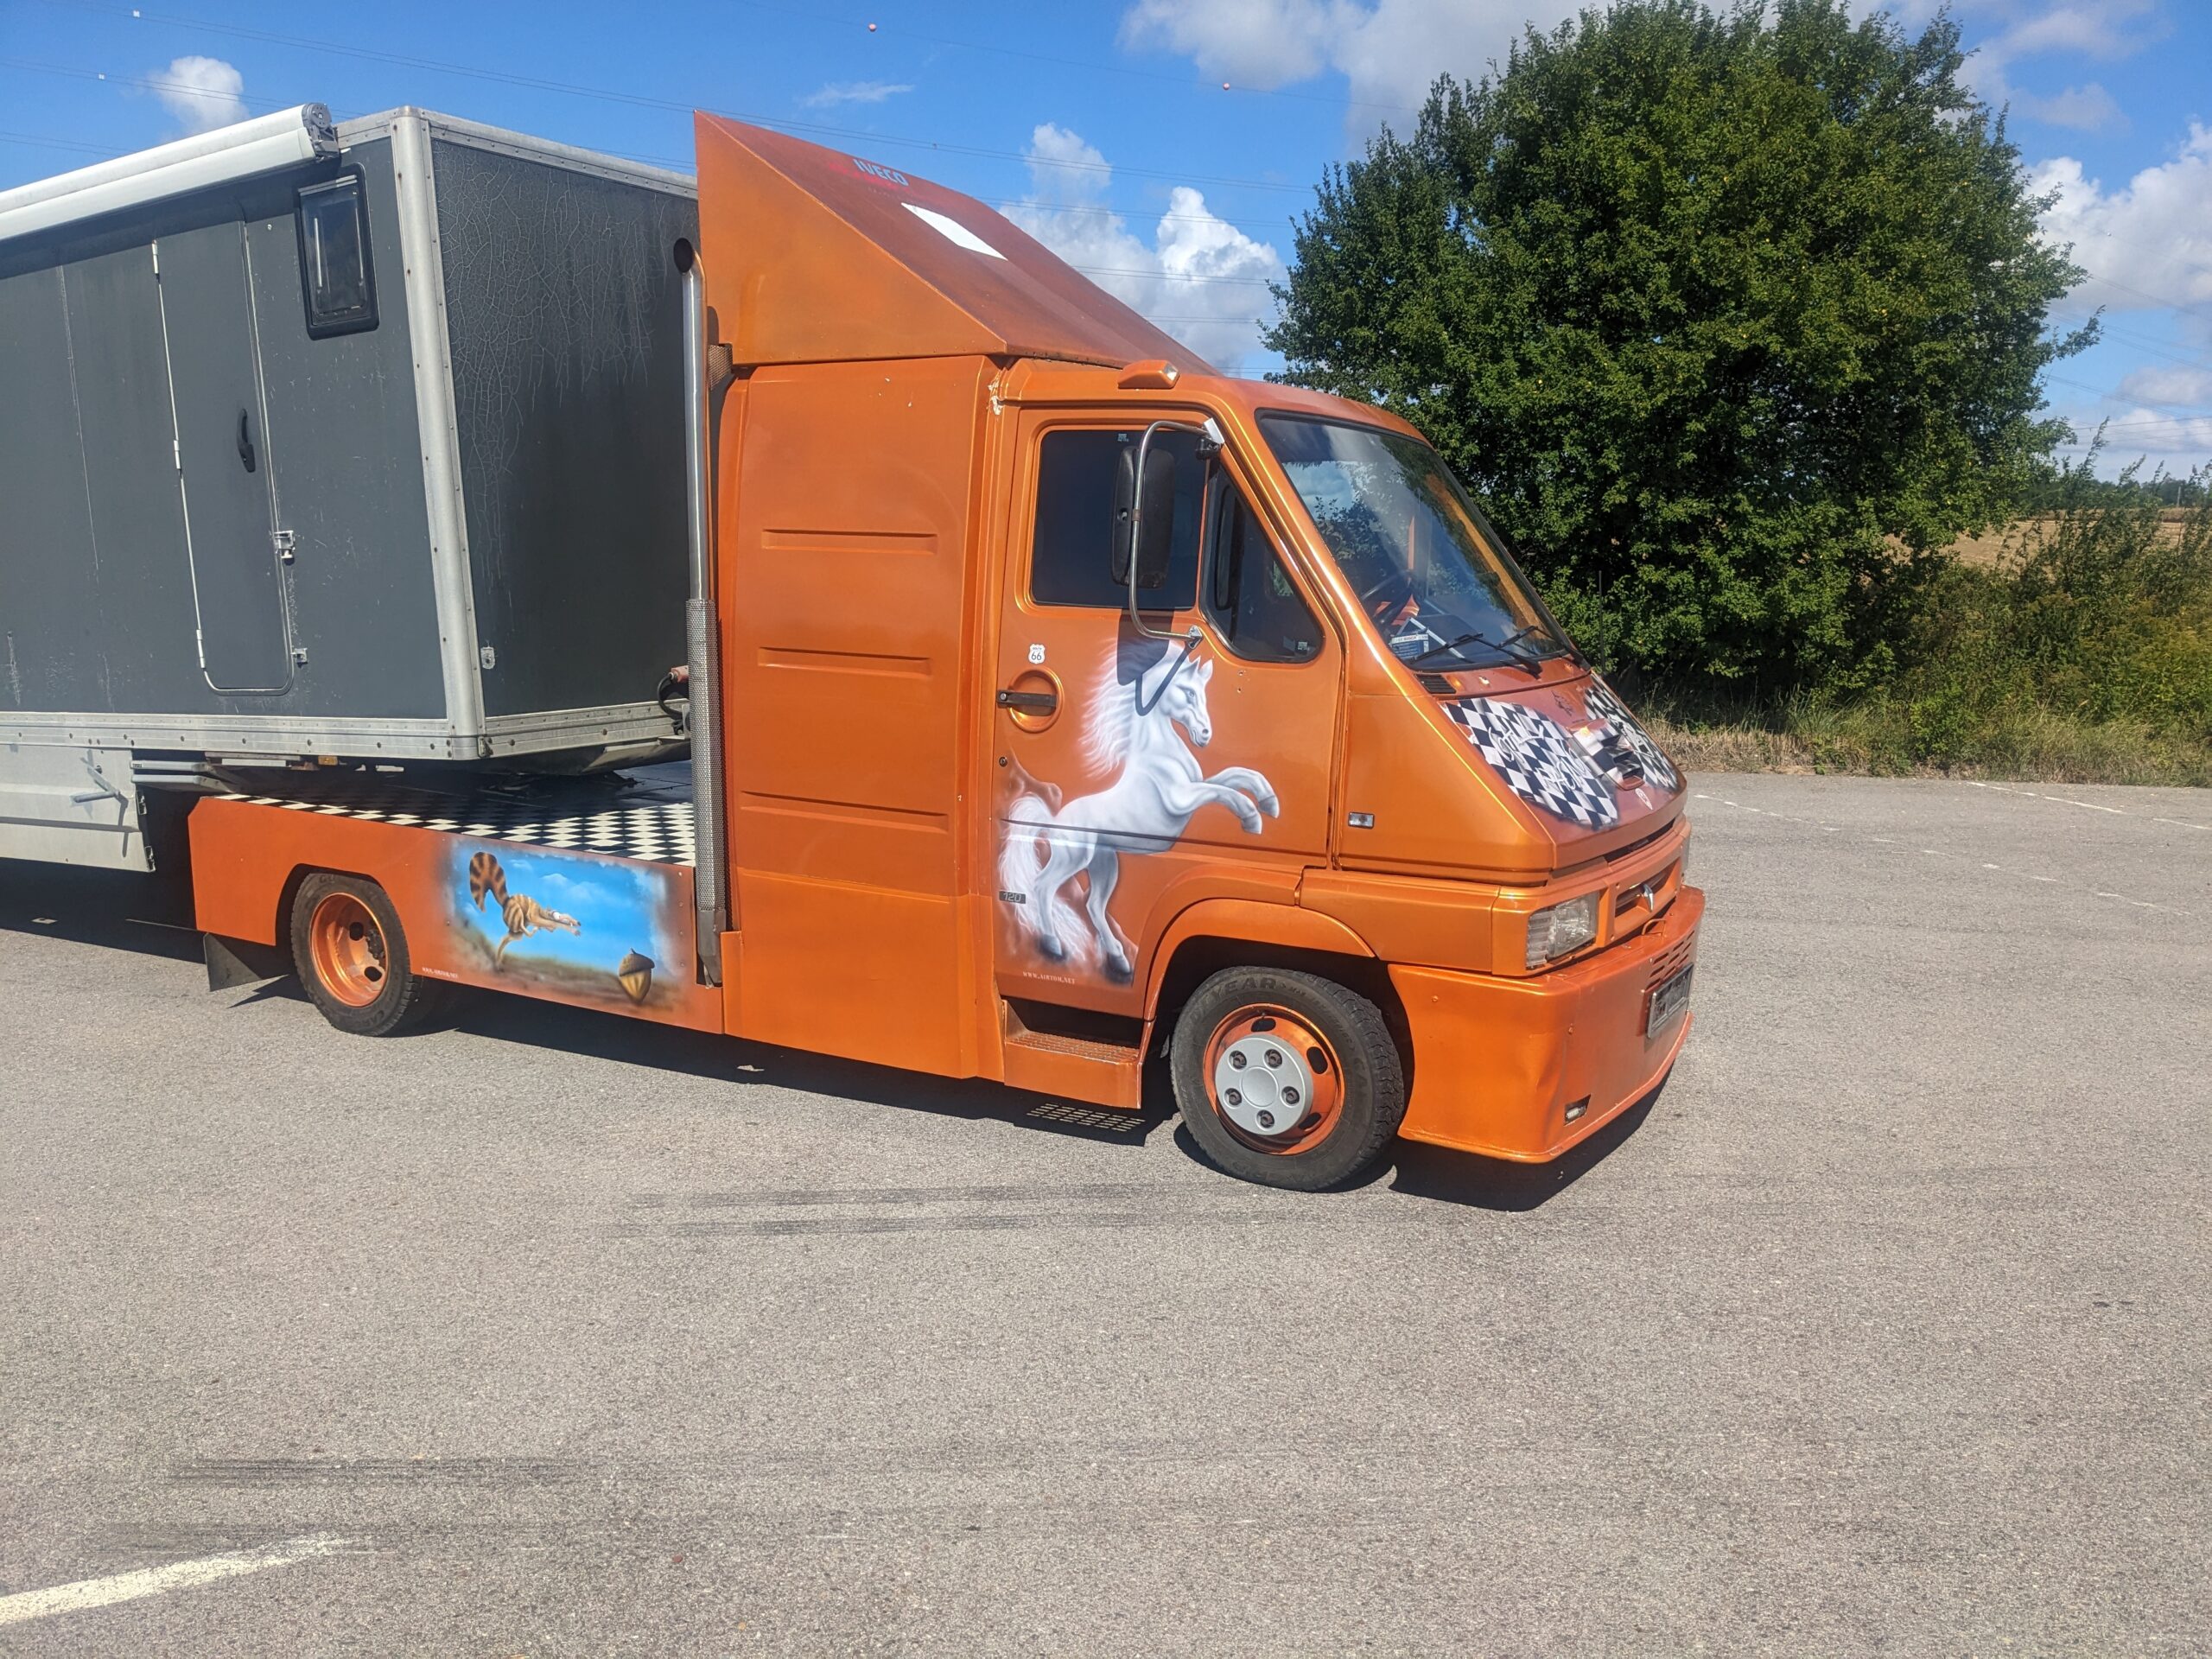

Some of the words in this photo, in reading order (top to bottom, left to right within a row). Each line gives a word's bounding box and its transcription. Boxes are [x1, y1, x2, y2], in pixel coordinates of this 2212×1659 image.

[853, 158, 909, 187] IVECO
[1031, 652, 1042, 661] 66
[1002, 892, 1021, 903] 120
